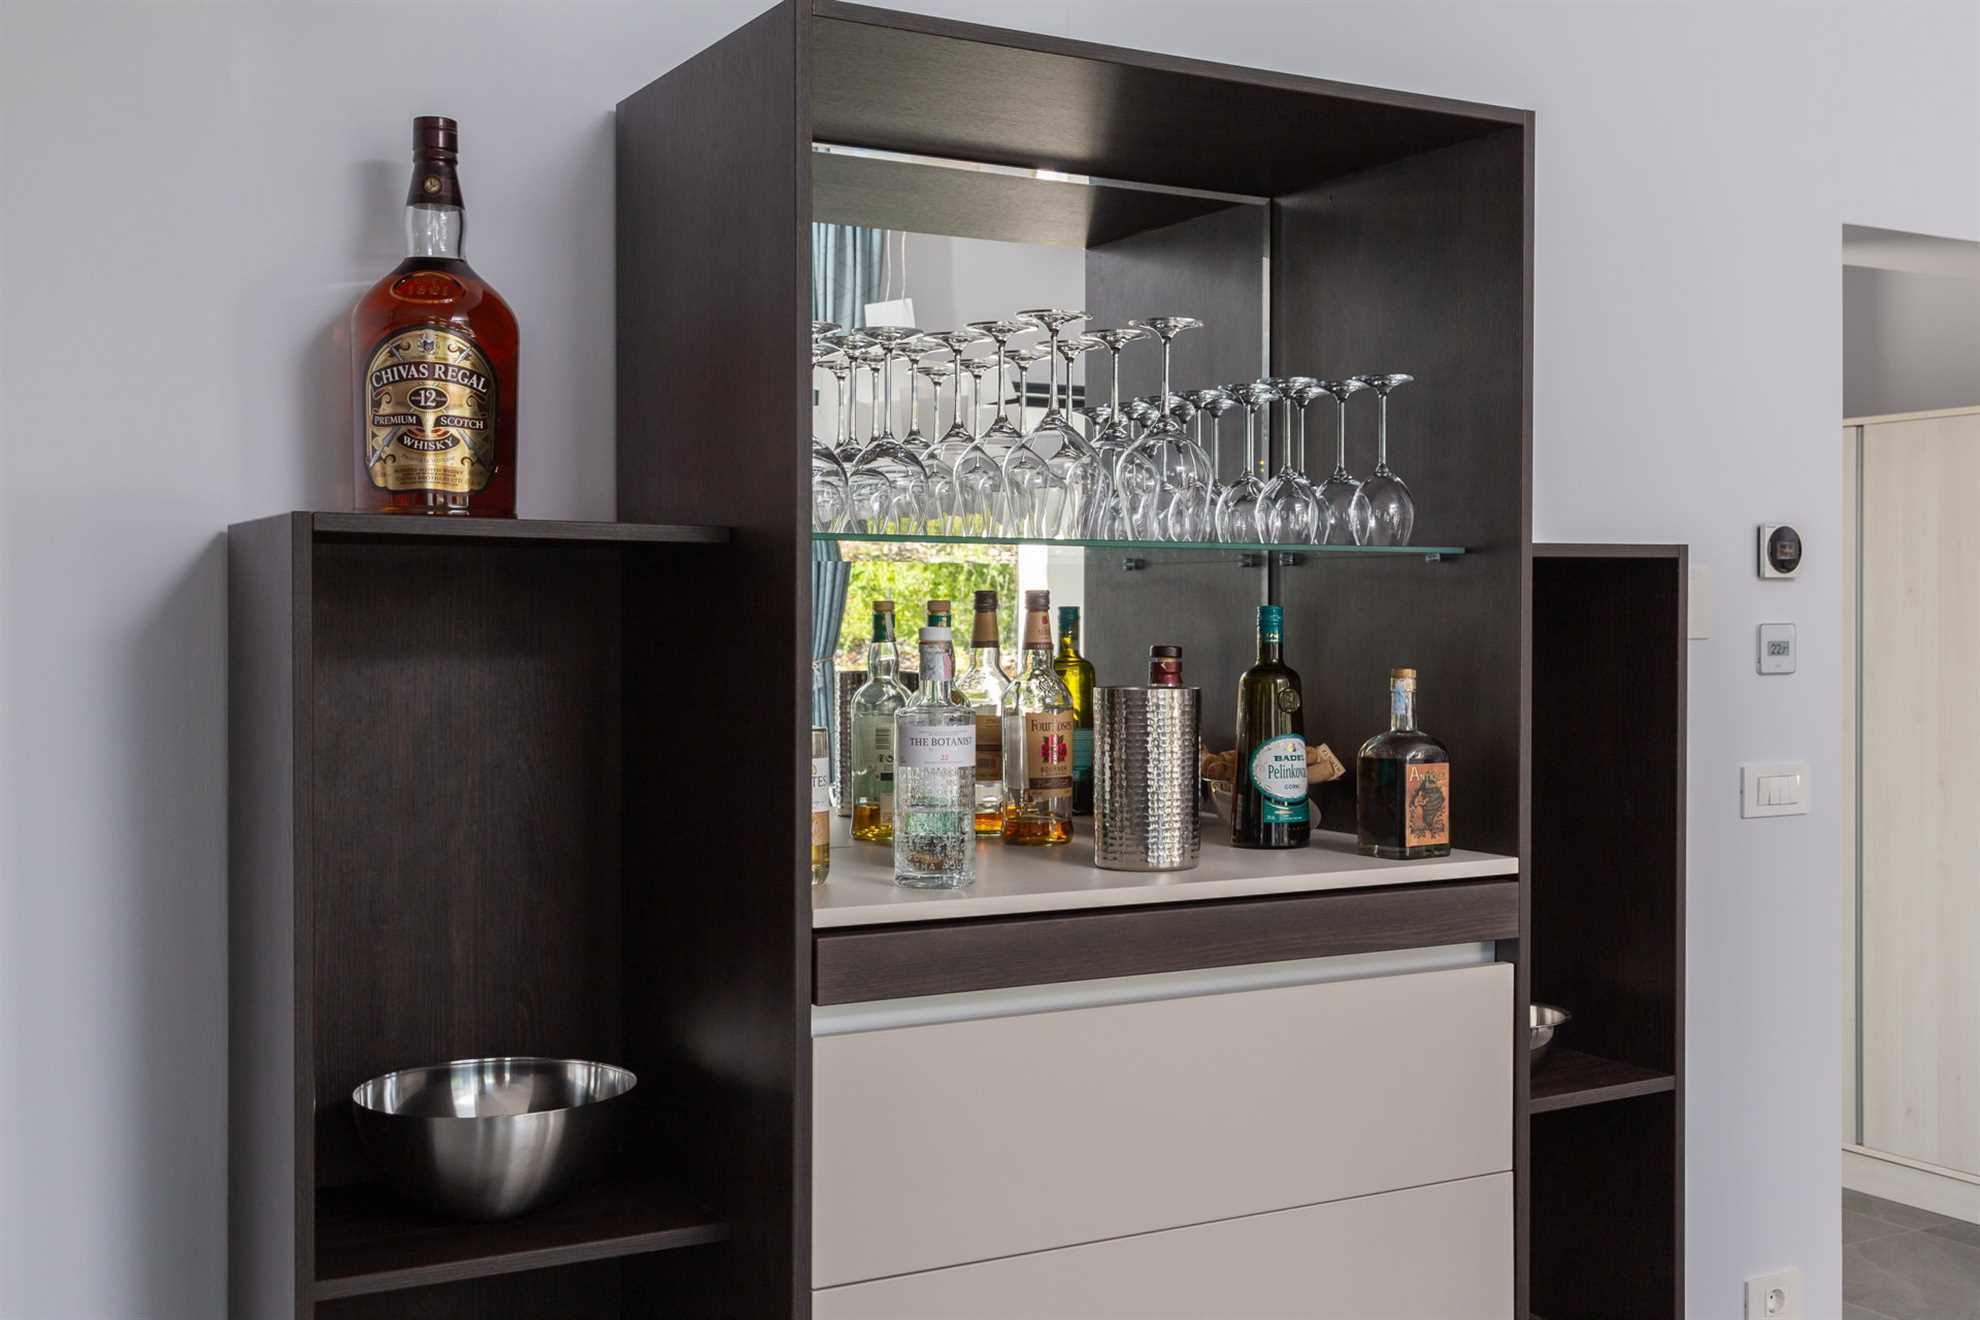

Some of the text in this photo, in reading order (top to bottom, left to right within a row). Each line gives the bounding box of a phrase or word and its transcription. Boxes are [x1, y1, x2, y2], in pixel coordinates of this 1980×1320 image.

[372, 363, 488, 393] CHIVAS REGAL
[419, 389, 437, 407] 12
[374, 415, 484, 429] PREMIUM SCOTCH
[403, 434, 455, 450] WHISKY
[910, 736, 929, 746] THE
[812, 775, 827, 788] TES
